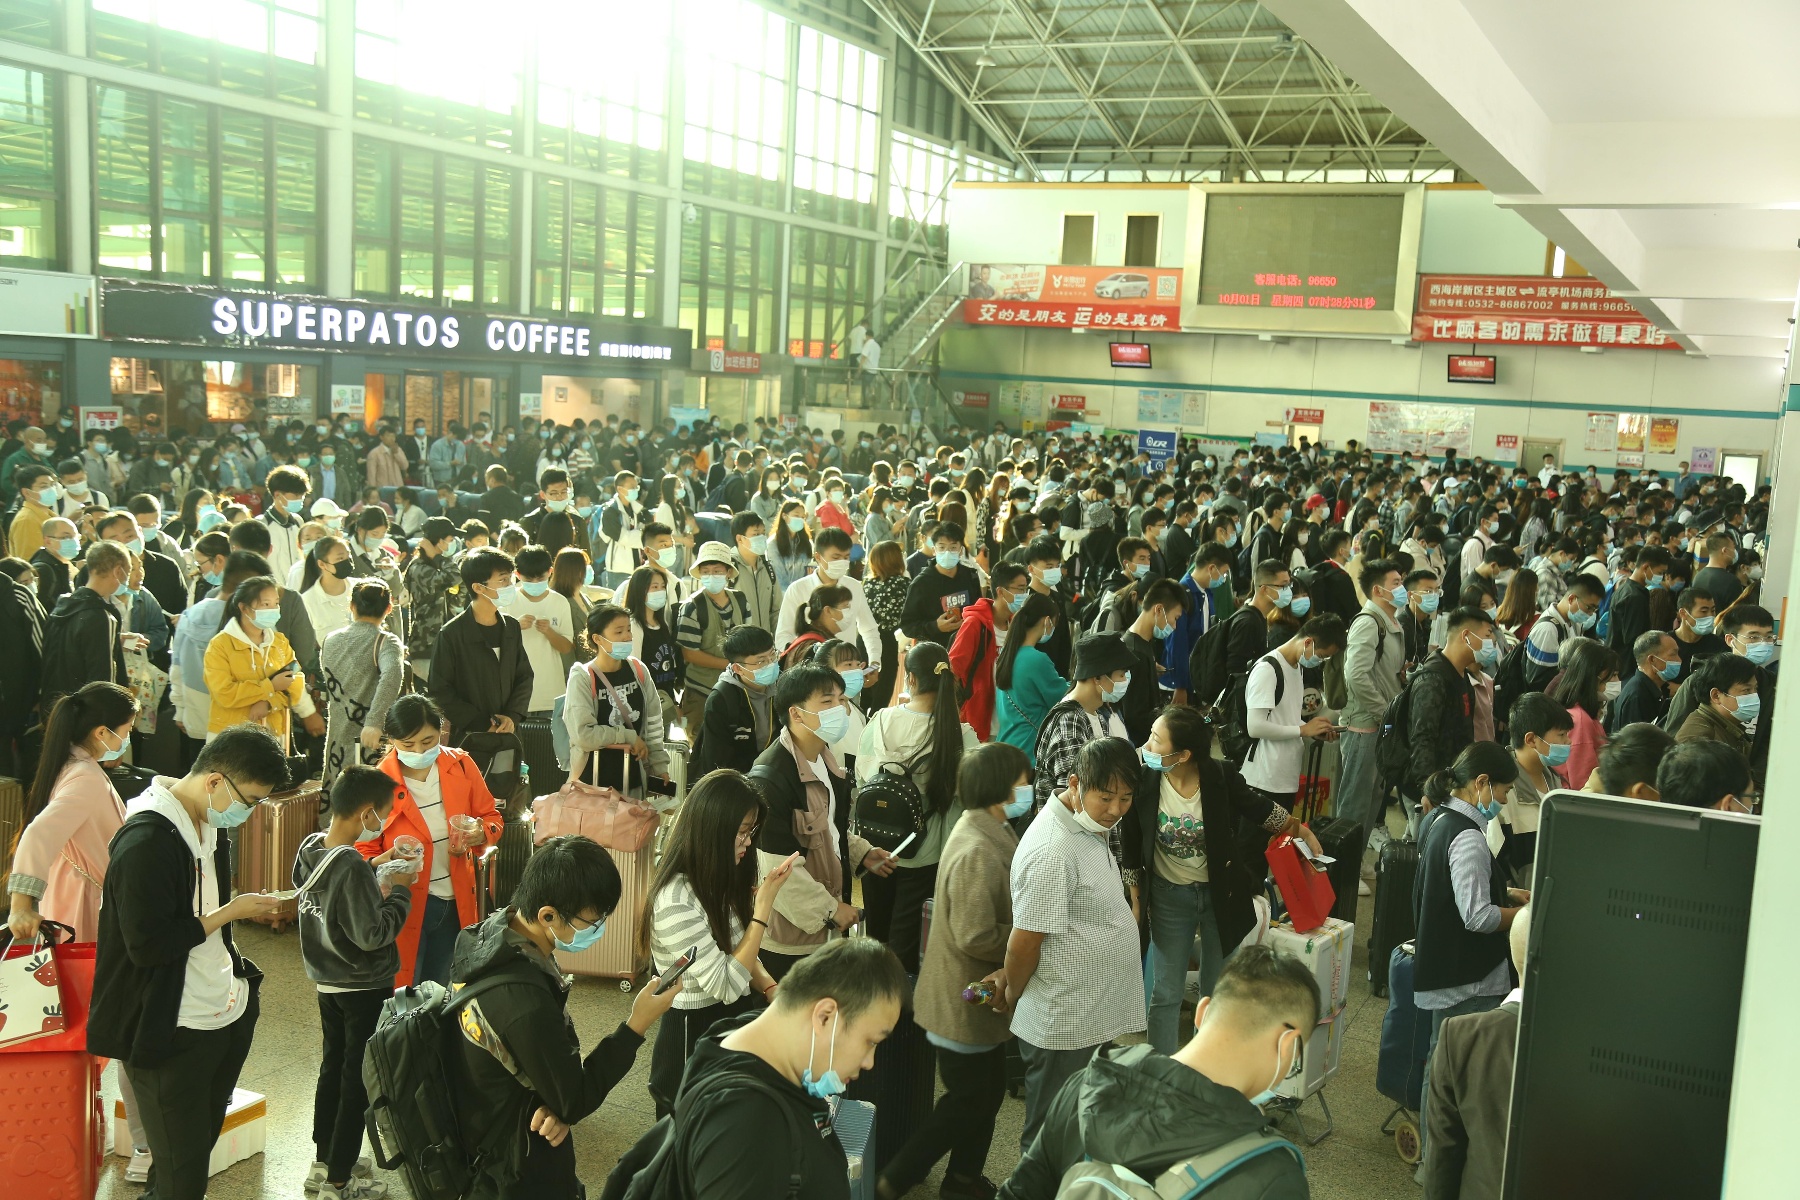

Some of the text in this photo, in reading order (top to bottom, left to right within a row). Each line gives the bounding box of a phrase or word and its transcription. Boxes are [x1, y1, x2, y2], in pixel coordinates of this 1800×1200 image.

[1307, 276, 1337, 286] 96650
[1430, 283, 1518, 297] 西海岸新区主城区
[1218, 293, 1376, 309] 10月01日 星期四 07时28分31秒
[978, 304, 1167, 327] 交的是朋友 运的是真情
[212, 297, 592, 357] SUPERPATOS COFFEE
[1432, 319, 1667, 346] 比顾客的需求做得更好
